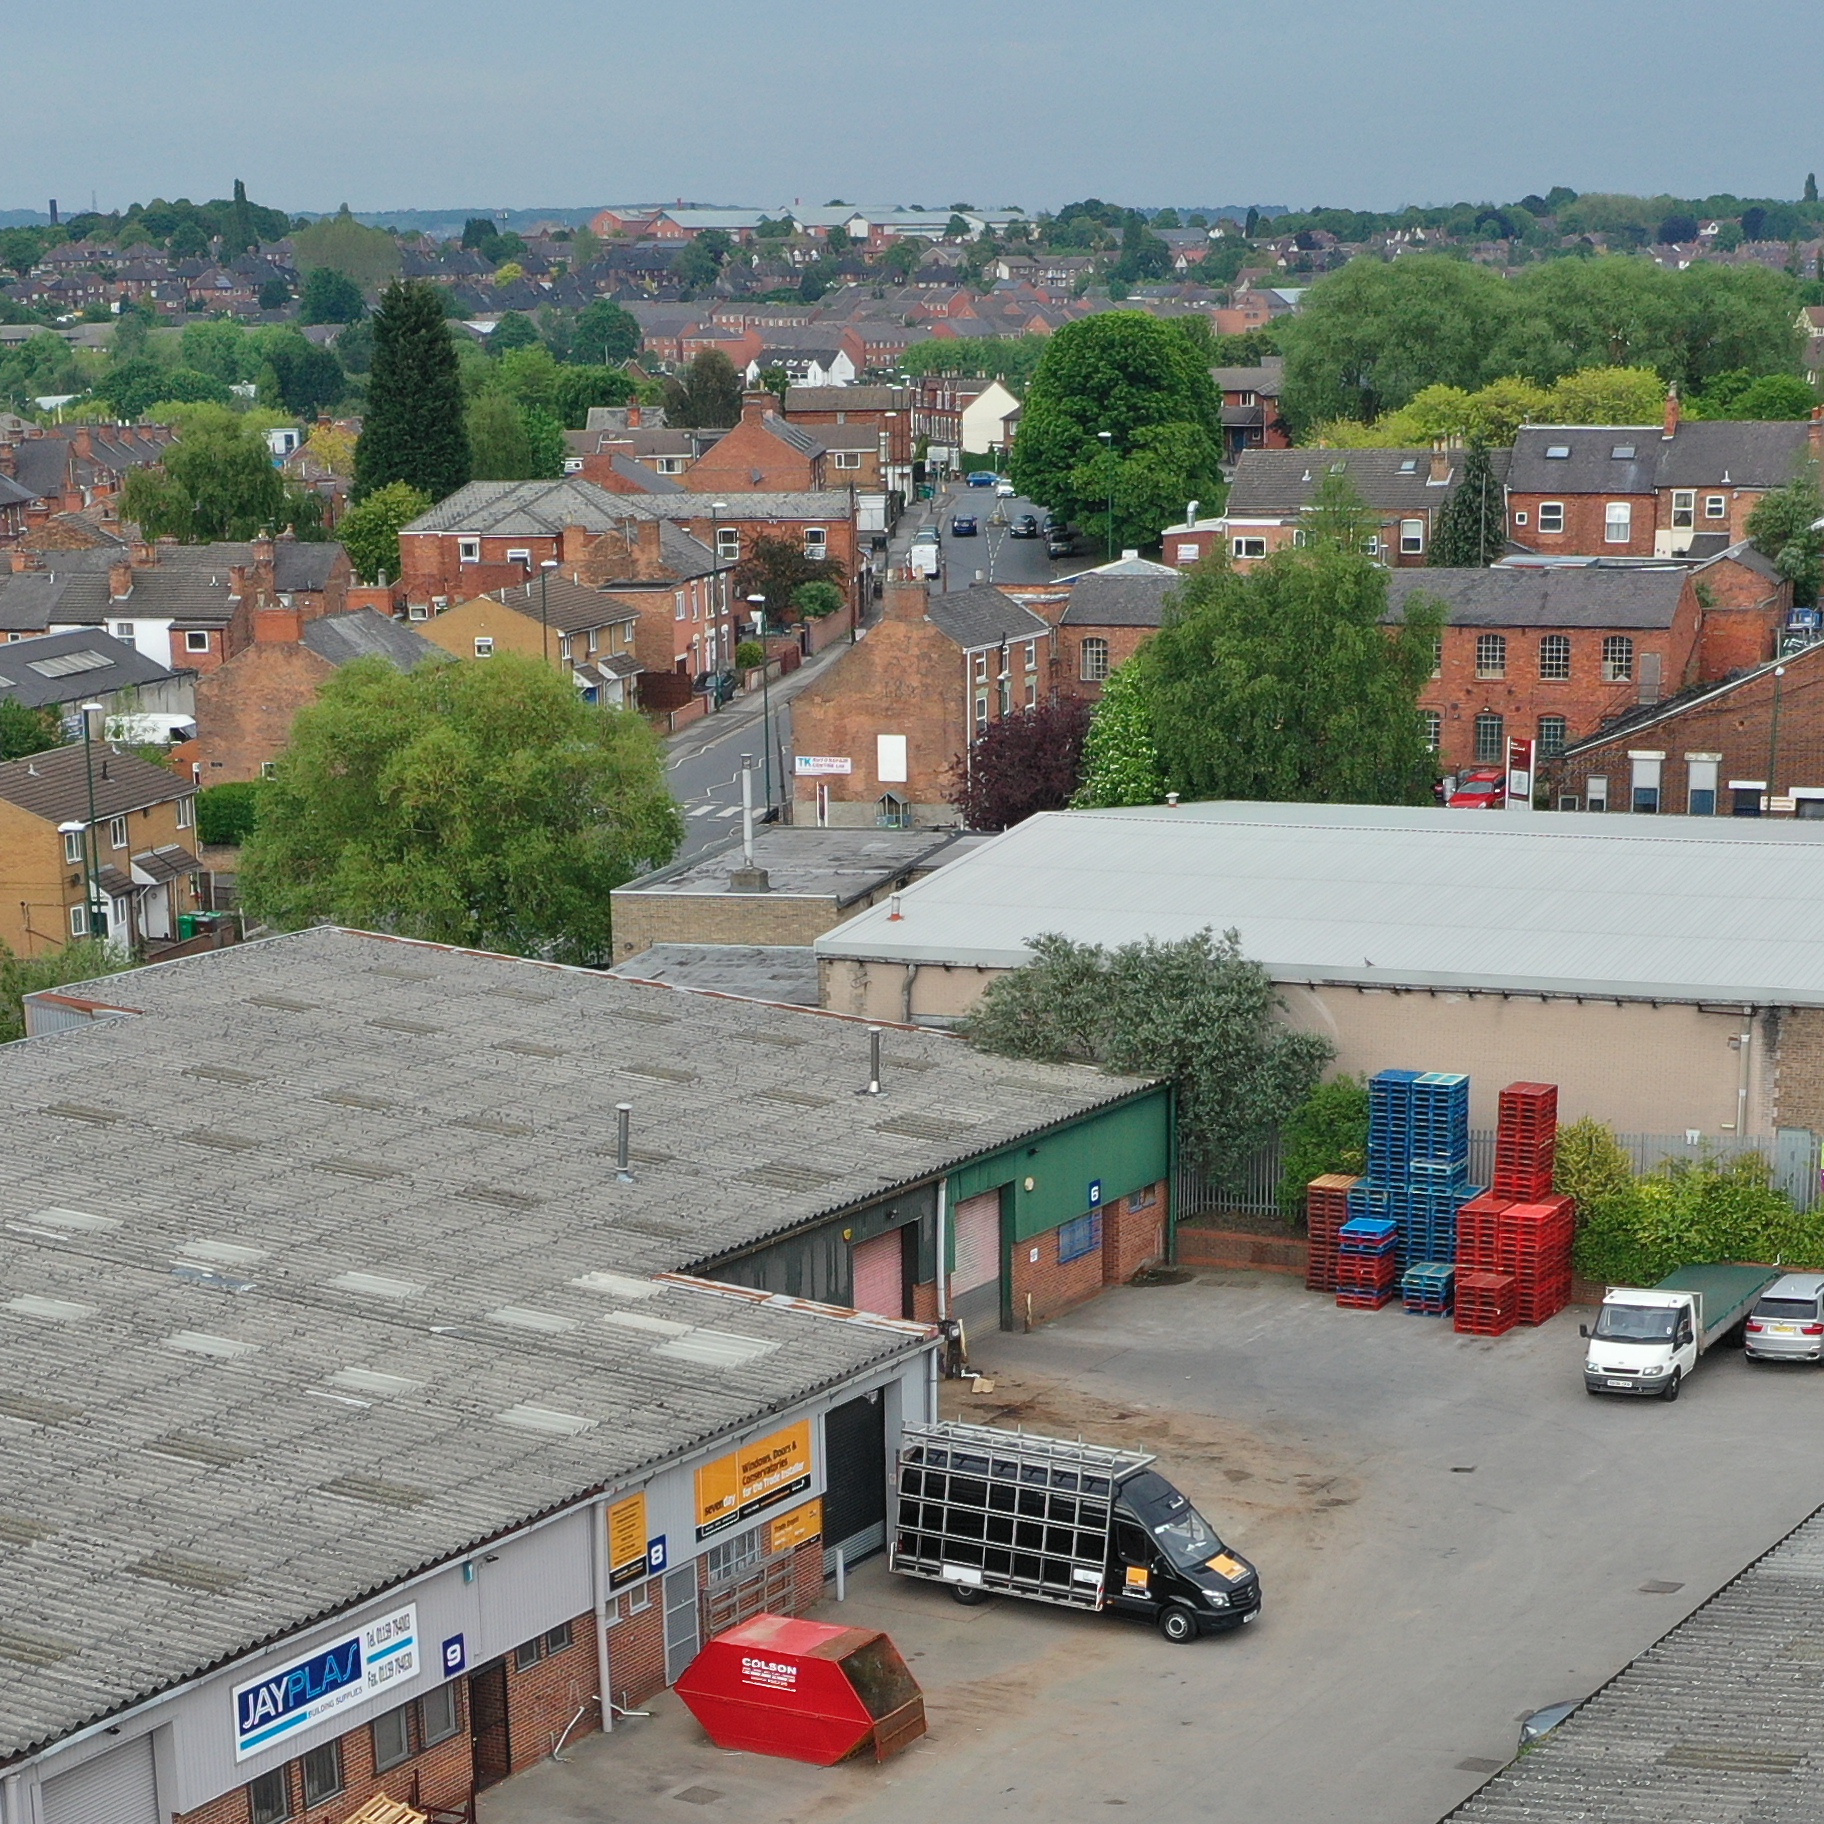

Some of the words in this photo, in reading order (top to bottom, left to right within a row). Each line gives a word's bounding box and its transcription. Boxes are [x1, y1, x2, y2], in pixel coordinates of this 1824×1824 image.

[1091, 1186, 1099, 1202] 6
[651, 1544, 663, 1565] 8
[447, 1644, 461, 1667] 9
[742, 1658, 797, 1675] COLSON
[308, 1699, 334, 1718] BUILDING
[335, 1686, 363, 1705] SUPPLIES
